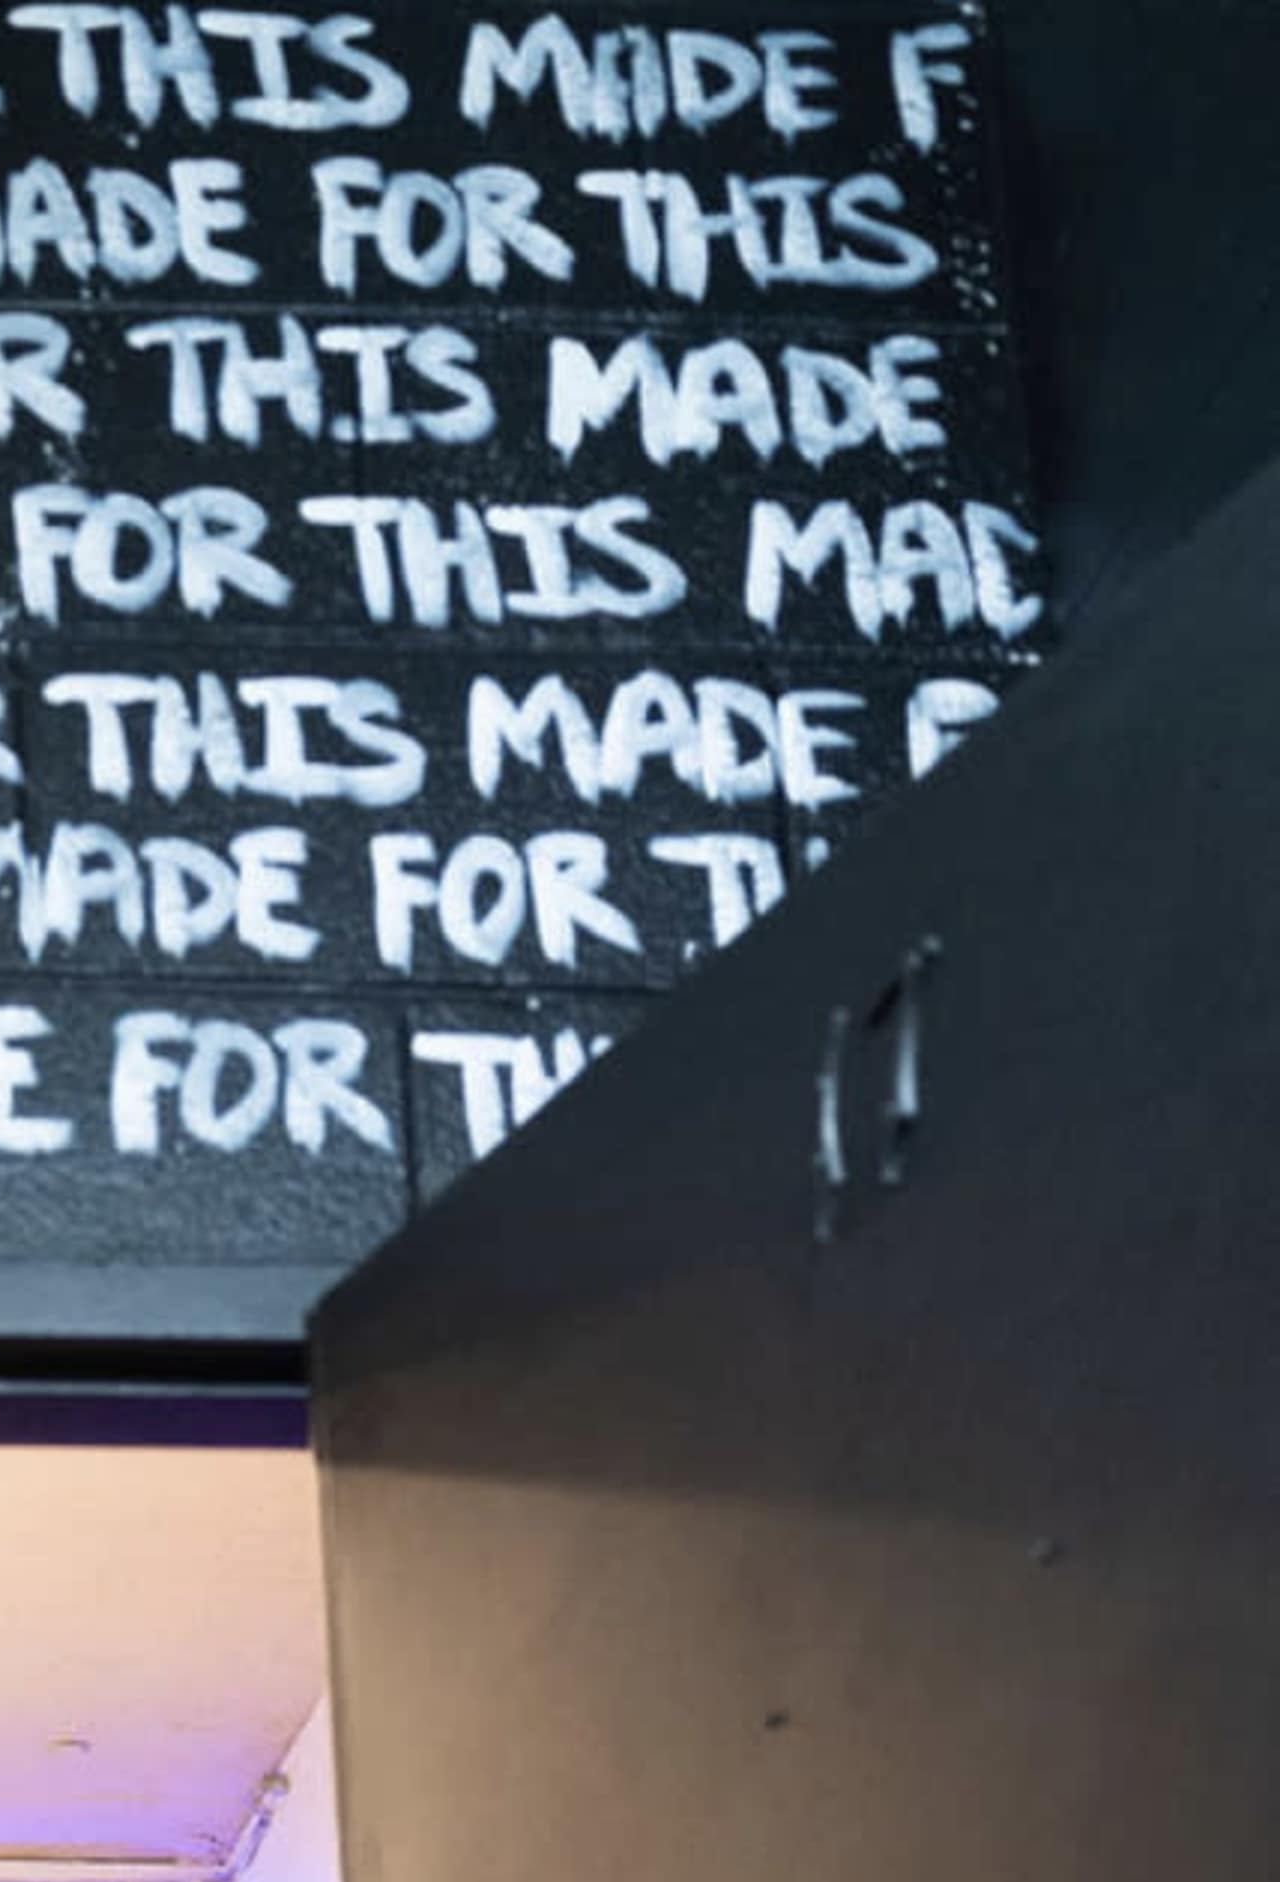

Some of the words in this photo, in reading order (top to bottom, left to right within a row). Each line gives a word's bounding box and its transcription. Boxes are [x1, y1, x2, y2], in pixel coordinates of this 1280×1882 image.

[8, 5, 408, 129] THIS
[460, 14, 831, 141] MADE
[312, 157, 573, 291] FOR
[577, 170, 937, 300] THIS
[127, 315, 494, 443] THIS
[548, 336, 943, 464] MADE
[13, 478, 290, 622] FOR
[299, 496, 686, 625] THIS
[43, 674, 426, 805] THIS
[468, 671, 861, 810] MADE
[370, 832, 639, 970] FOR
[110, 1012, 392, 1154] FOR
